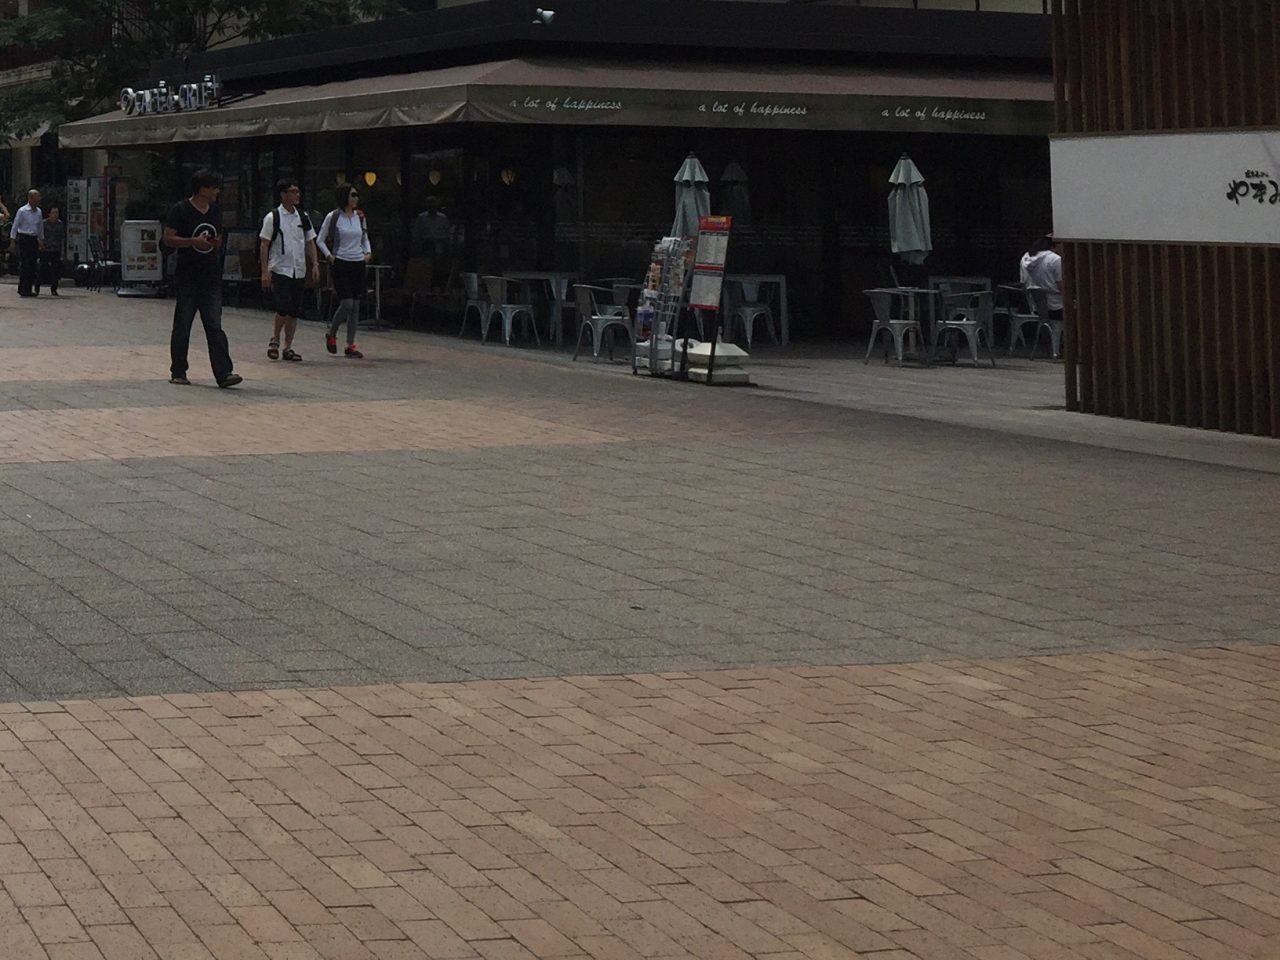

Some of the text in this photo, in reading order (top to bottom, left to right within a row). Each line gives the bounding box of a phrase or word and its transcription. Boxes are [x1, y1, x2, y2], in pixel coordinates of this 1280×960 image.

[523, 97, 539, 108] lot
[545, 98, 557, 112] of
[562, 97, 623, 112] happiness
[698, 101, 808, 117] a lot of happiness
[881, 106, 986, 121] a lot of happiness
